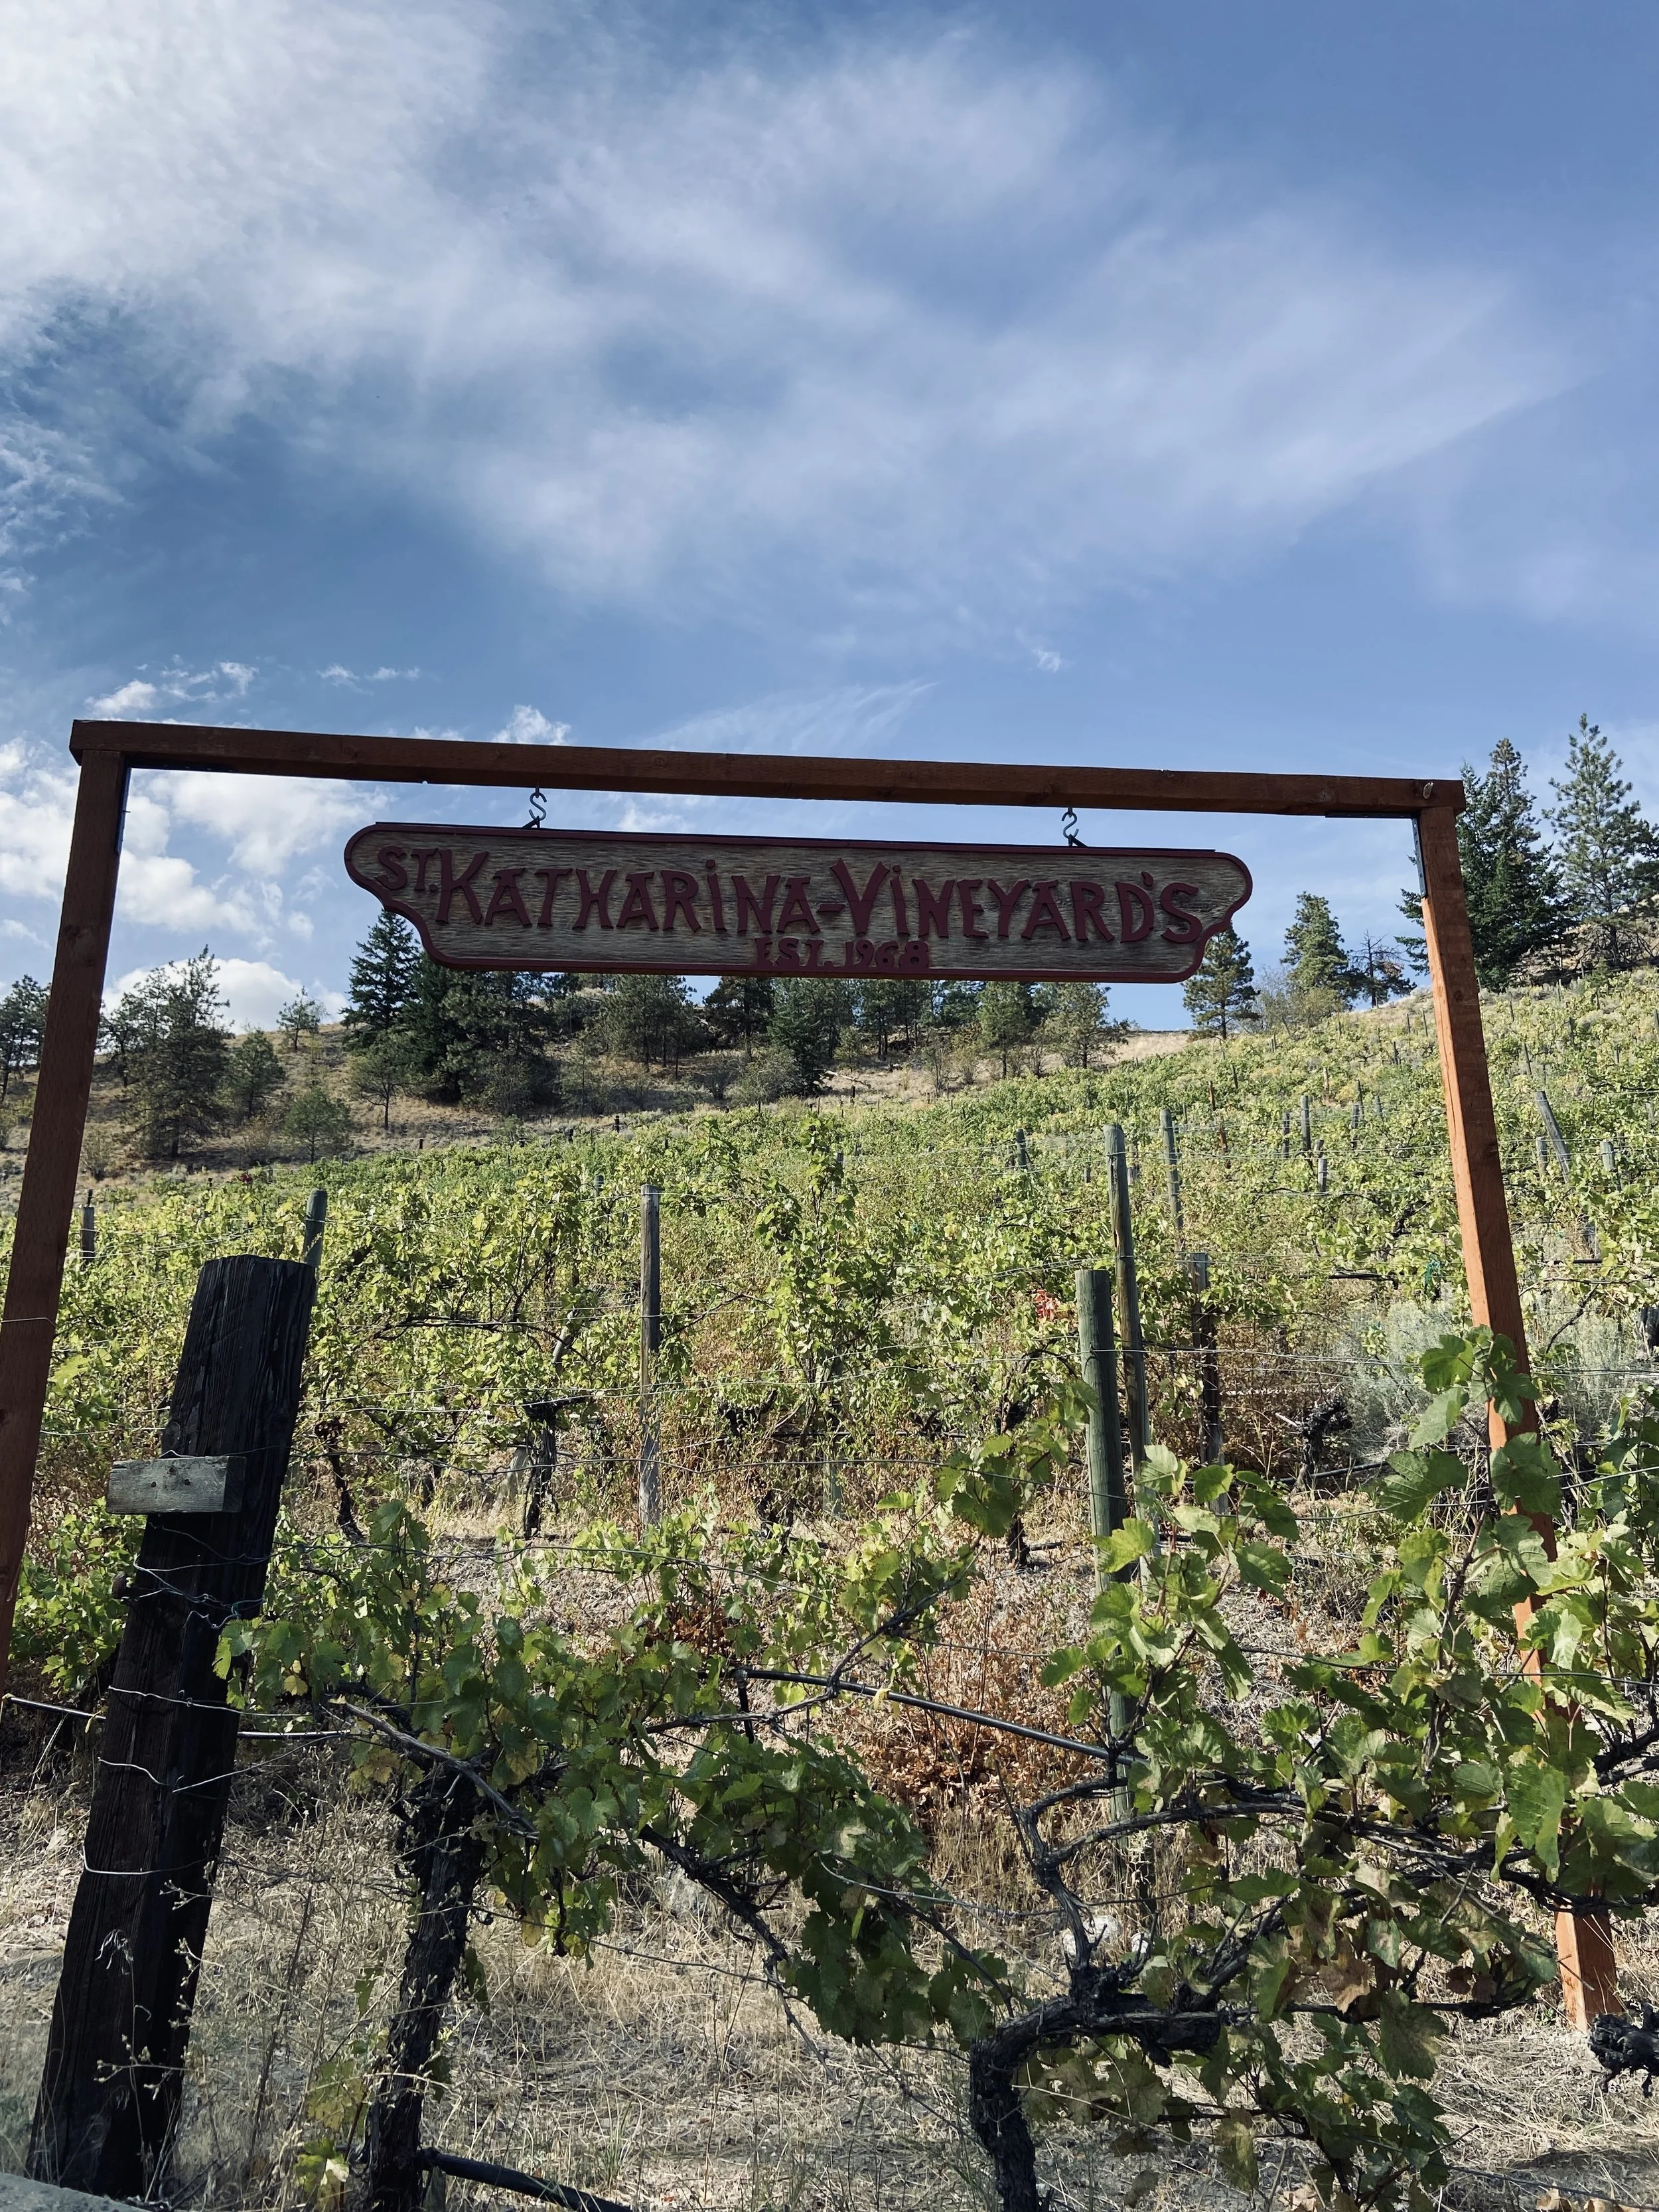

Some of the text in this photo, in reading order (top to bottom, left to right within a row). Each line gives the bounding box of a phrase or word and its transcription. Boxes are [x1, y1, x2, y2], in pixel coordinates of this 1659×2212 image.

[376, 846, 439, 891] ST.
[755, 937, 928, 968] EST. 1968
